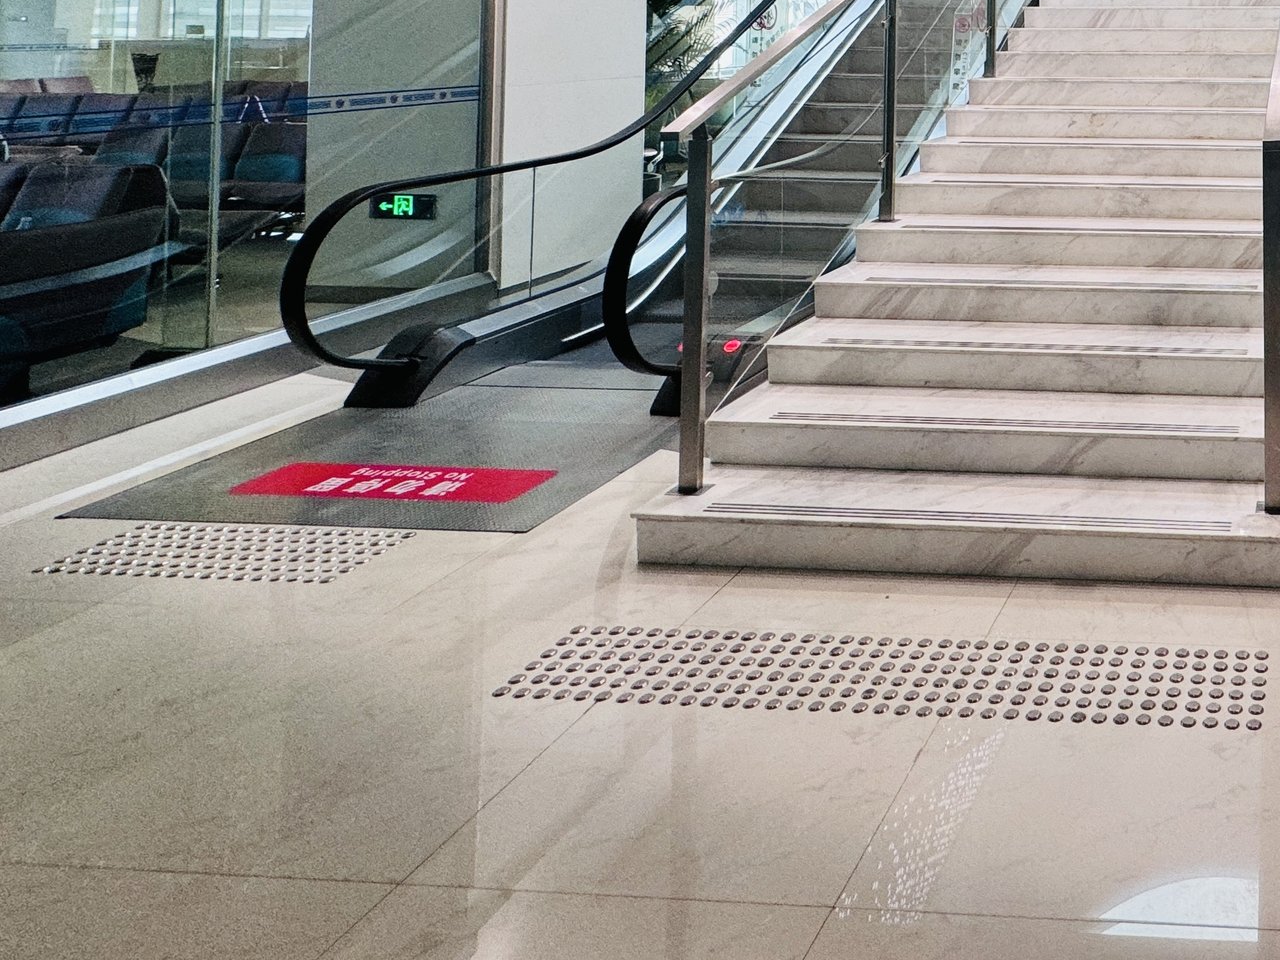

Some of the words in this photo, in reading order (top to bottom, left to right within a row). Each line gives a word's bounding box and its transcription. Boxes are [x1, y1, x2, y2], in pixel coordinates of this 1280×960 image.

[349, 467, 443, 481] Stopping
[443, 471, 474, 481] No
[302, 476, 467, 497] 请勿停留
